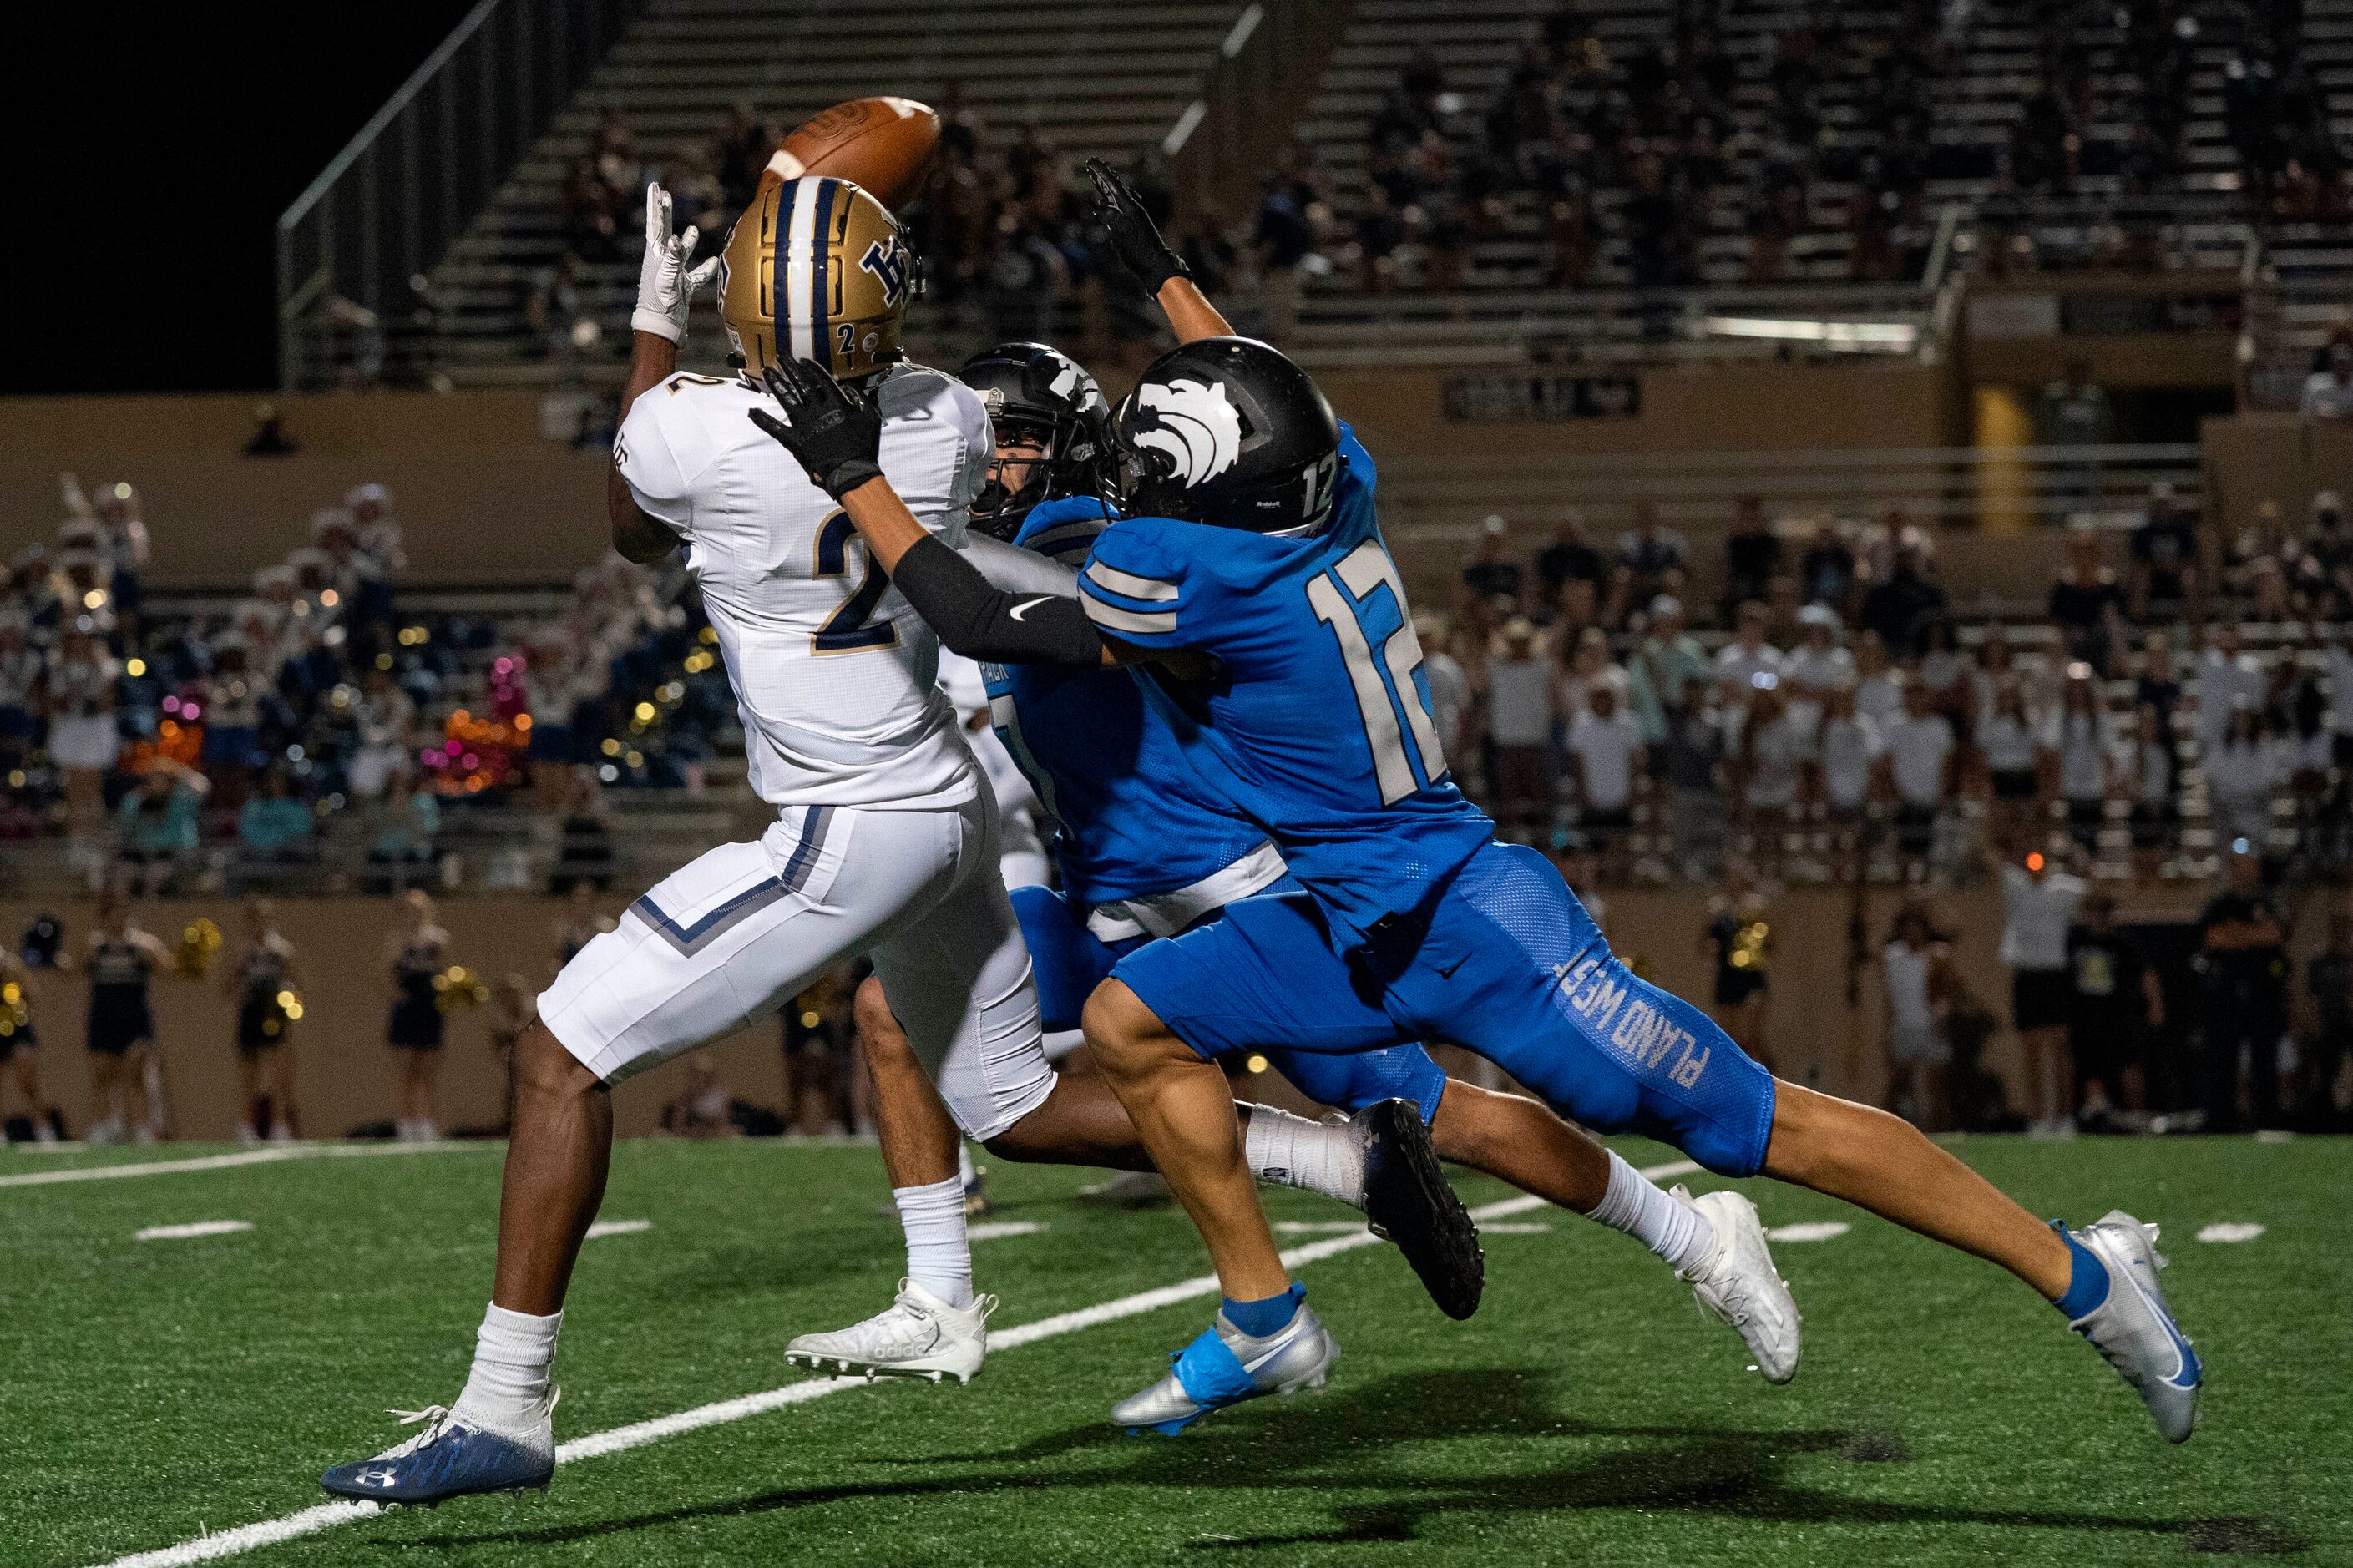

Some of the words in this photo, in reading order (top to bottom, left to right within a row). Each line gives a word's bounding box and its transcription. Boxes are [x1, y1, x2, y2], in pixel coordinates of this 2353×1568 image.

[837, 323, 855, 354] 2
[1303, 451, 1338, 518] 12
[810, 505, 901, 656] 2
[1304, 537, 1450, 807] 12
[1553, 948, 1627, 1030] WEST
[1612, 999, 1711, 1090] PLANO
